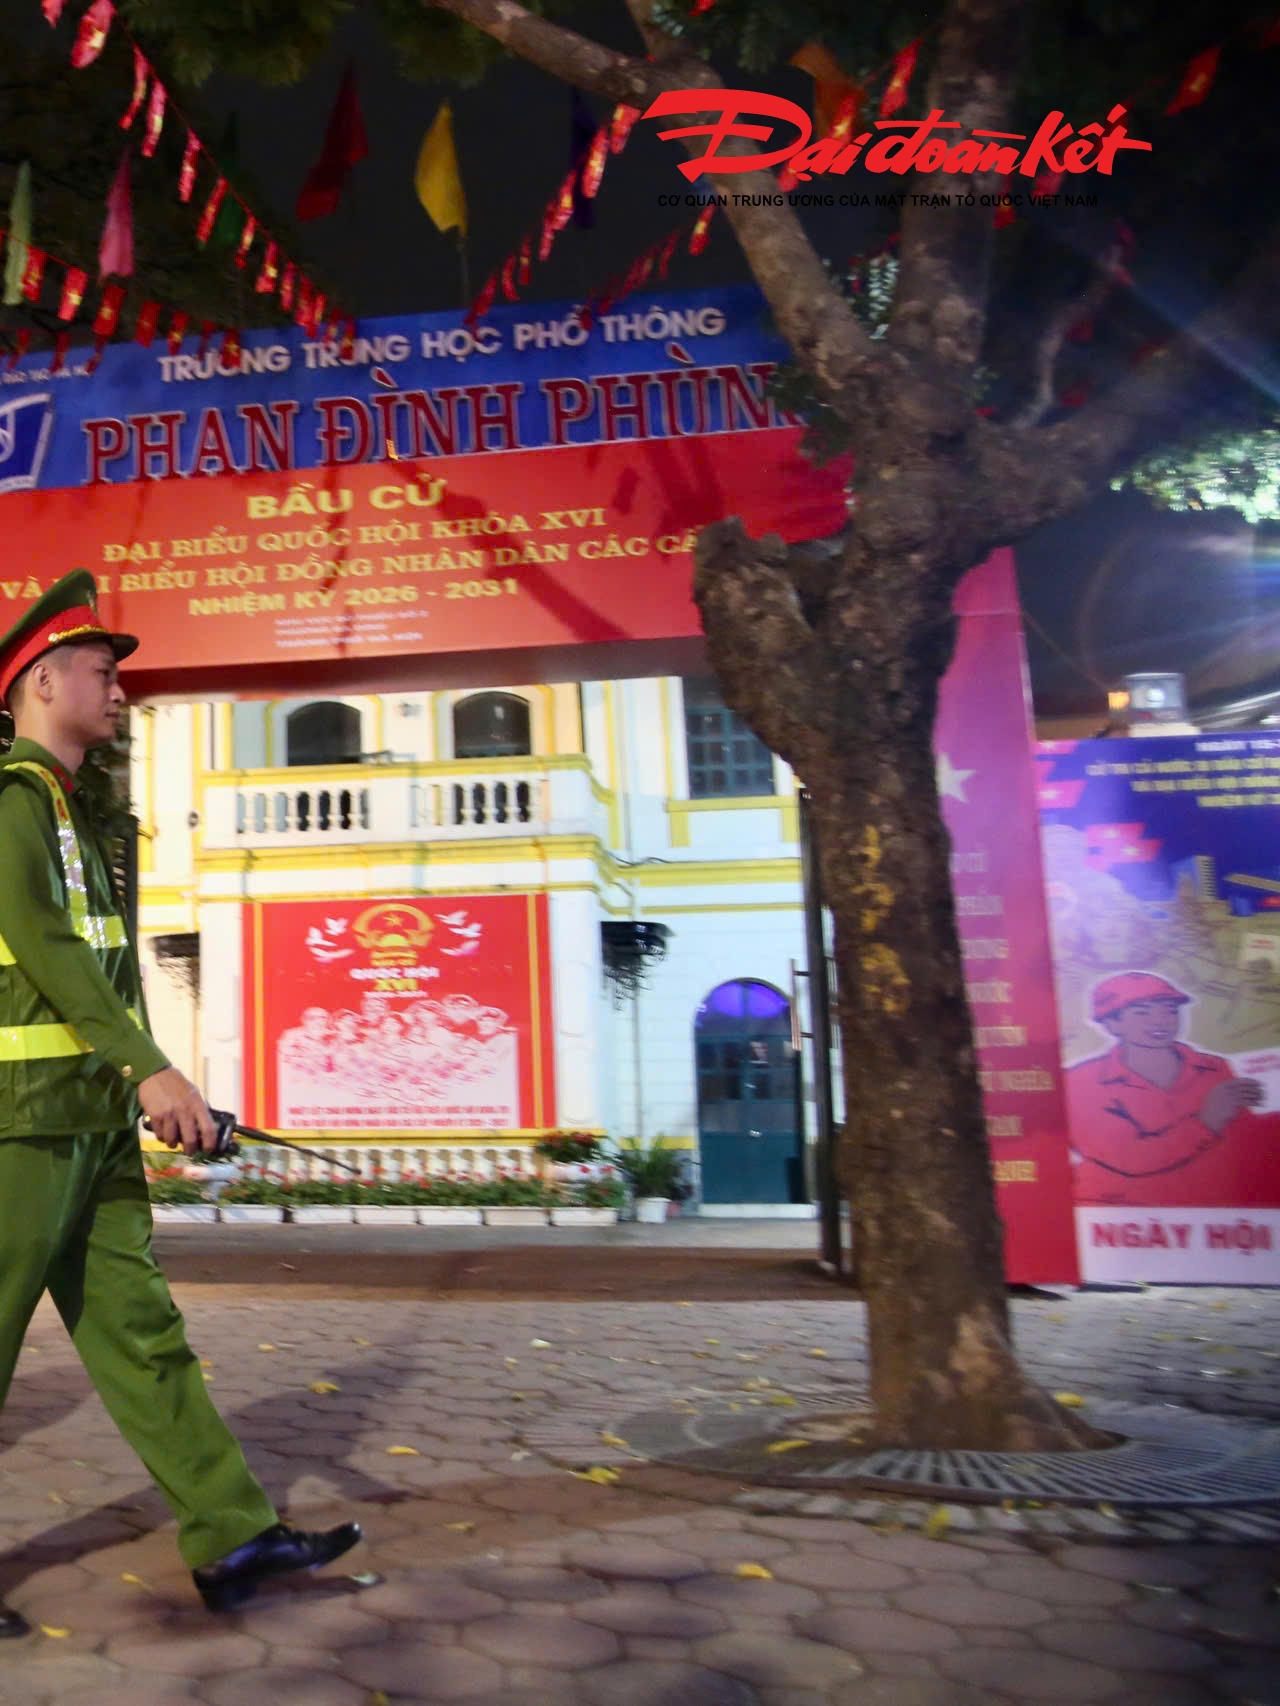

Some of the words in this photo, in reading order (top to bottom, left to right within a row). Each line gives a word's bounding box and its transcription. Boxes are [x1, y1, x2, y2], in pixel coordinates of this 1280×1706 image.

[422, 326, 503, 363] HỌC
[598, 305, 727, 343] THÔNG
[81, 400, 300, 485] PHAN
[314, 366, 523, 466] ĐÌNH
[540, 341, 808, 446] PHÙN
[247, 482, 353, 520] BẦU
[370, 473, 447, 510] CỬ
[0, 575, 44, 600] VÀ
[121, 561, 196, 593] BIỂU
[206, 562, 268, 588] HỘI
[276, 552, 372, 582] ĐỒNG
[382, 546, 484, 574] NHÂN
[494, 541, 571, 567] DÂN
[578, 533, 650, 560] CÁC
[656, 524, 697, 553] CẤ
[103, 543, 161, 565] ĐẠI
[171, 525, 248, 558] BIỂU
[257, 520, 351, 552] QUỐC
[358, 518, 421, 546] HỘI
[539, 507, 606, 530] XVI
[188, 590, 286, 617] NHIỆM
[344, 584, 419, 606] 2026
[444, 578, 518, 600] 2031
[1091, 1216, 1193, 1249] NGÀY
[1205, 1217, 1274, 1257] HỘI
